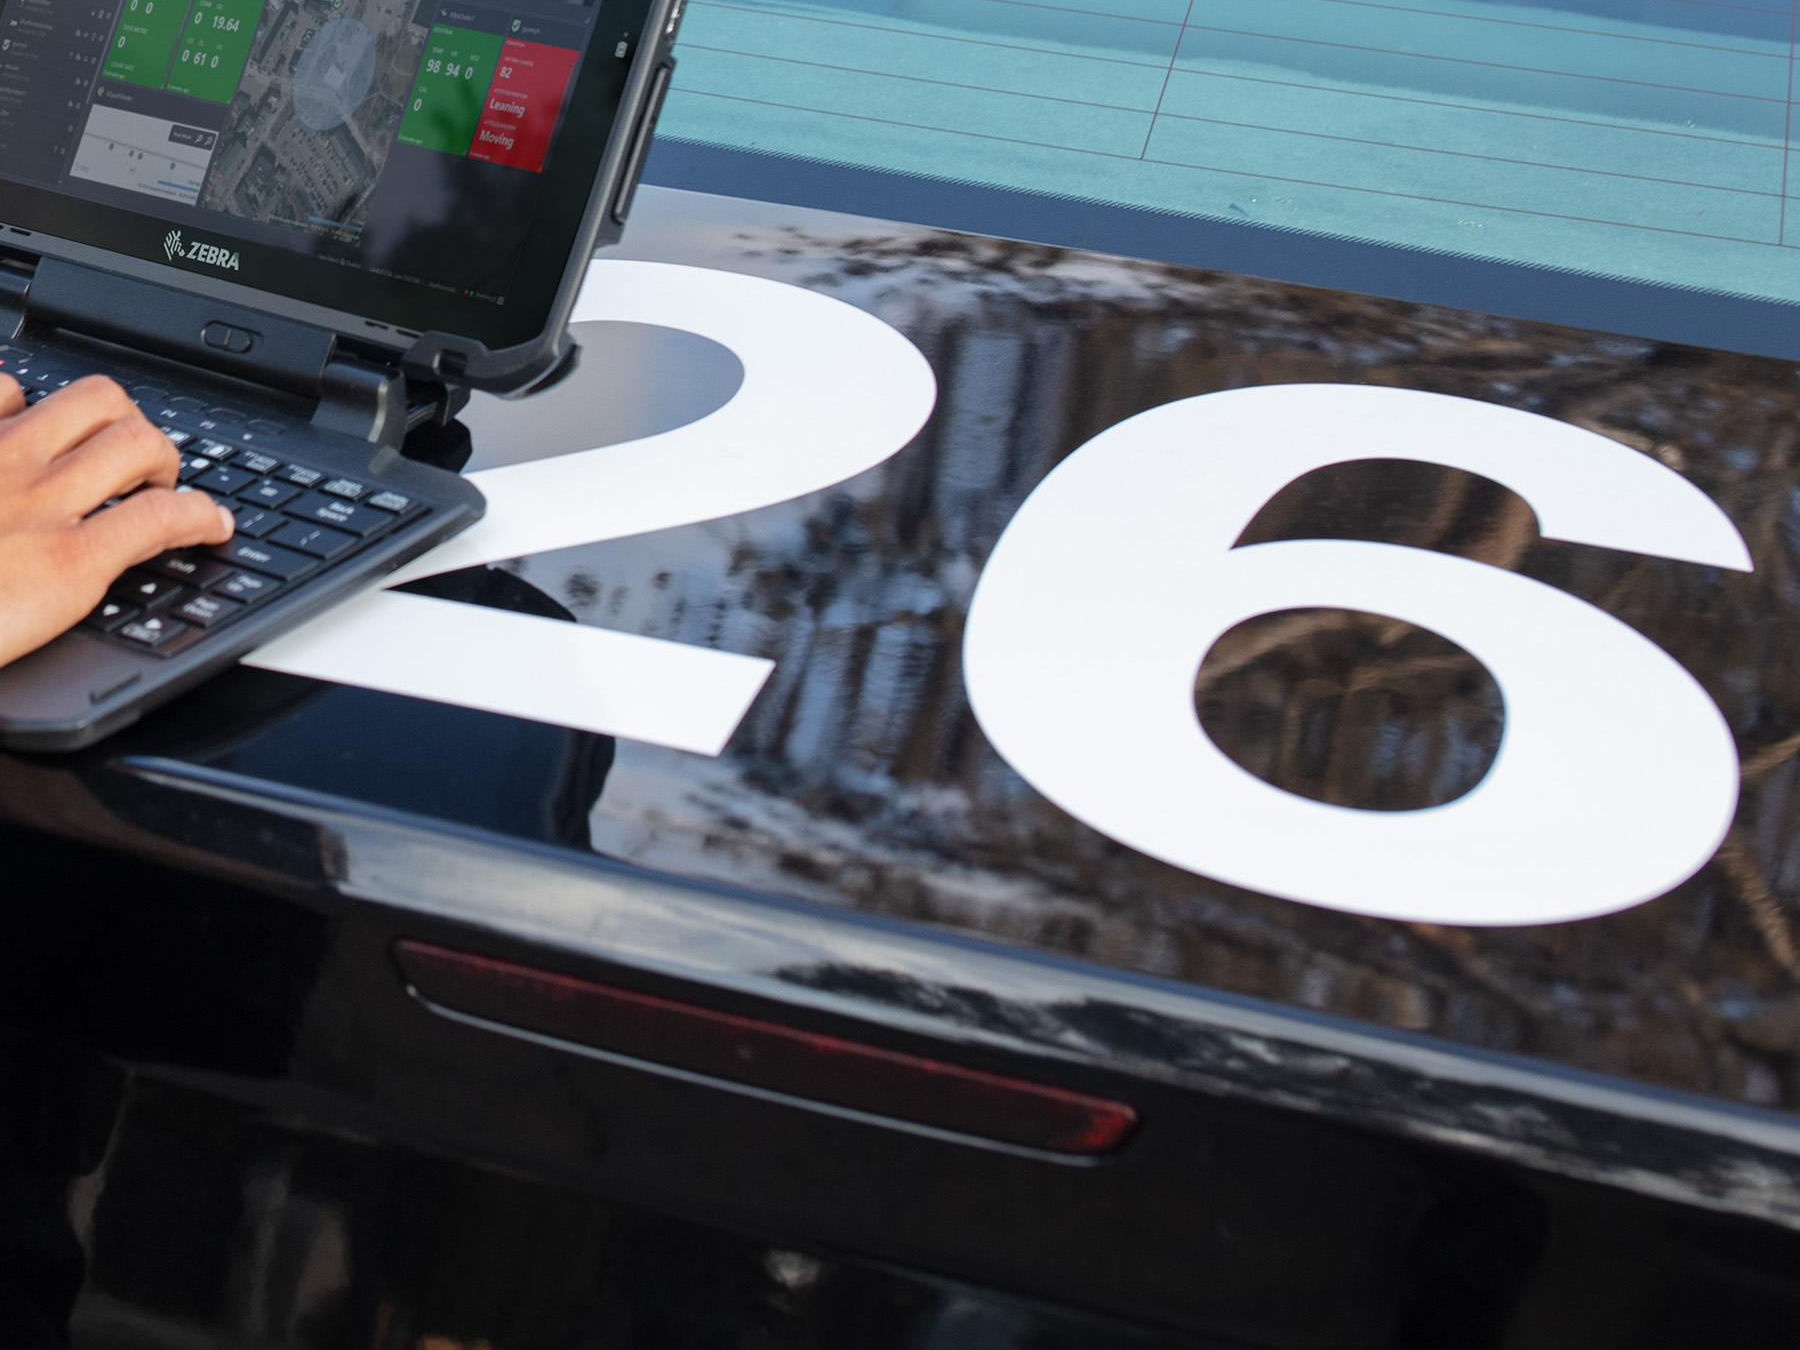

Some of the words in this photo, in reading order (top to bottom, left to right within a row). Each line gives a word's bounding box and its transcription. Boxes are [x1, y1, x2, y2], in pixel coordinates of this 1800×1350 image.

[144, 0, 154, 14] 0
[193, 10, 203, 24] 0
[211, 14, 240, 32] 19.64
[117, 35, 126, 48] 0
[181, 49, 190, 62] 0
[192, 51, 207, 66] 61
[210, 55, 219, 68] 0
[425, 57, 441, 74] 98
[444, 62, 460, 77] 94
[464, 66, 473, 80] 0
[499, 65, 512, 79] 82
[412, 97, 422, 112] 0
[488, 97, 526, 118] Leaning
[478, 129, 514, 150] Moving
[185, 241, 240, 271] ZEBRA
[241, 258, 1754, 927] 26
